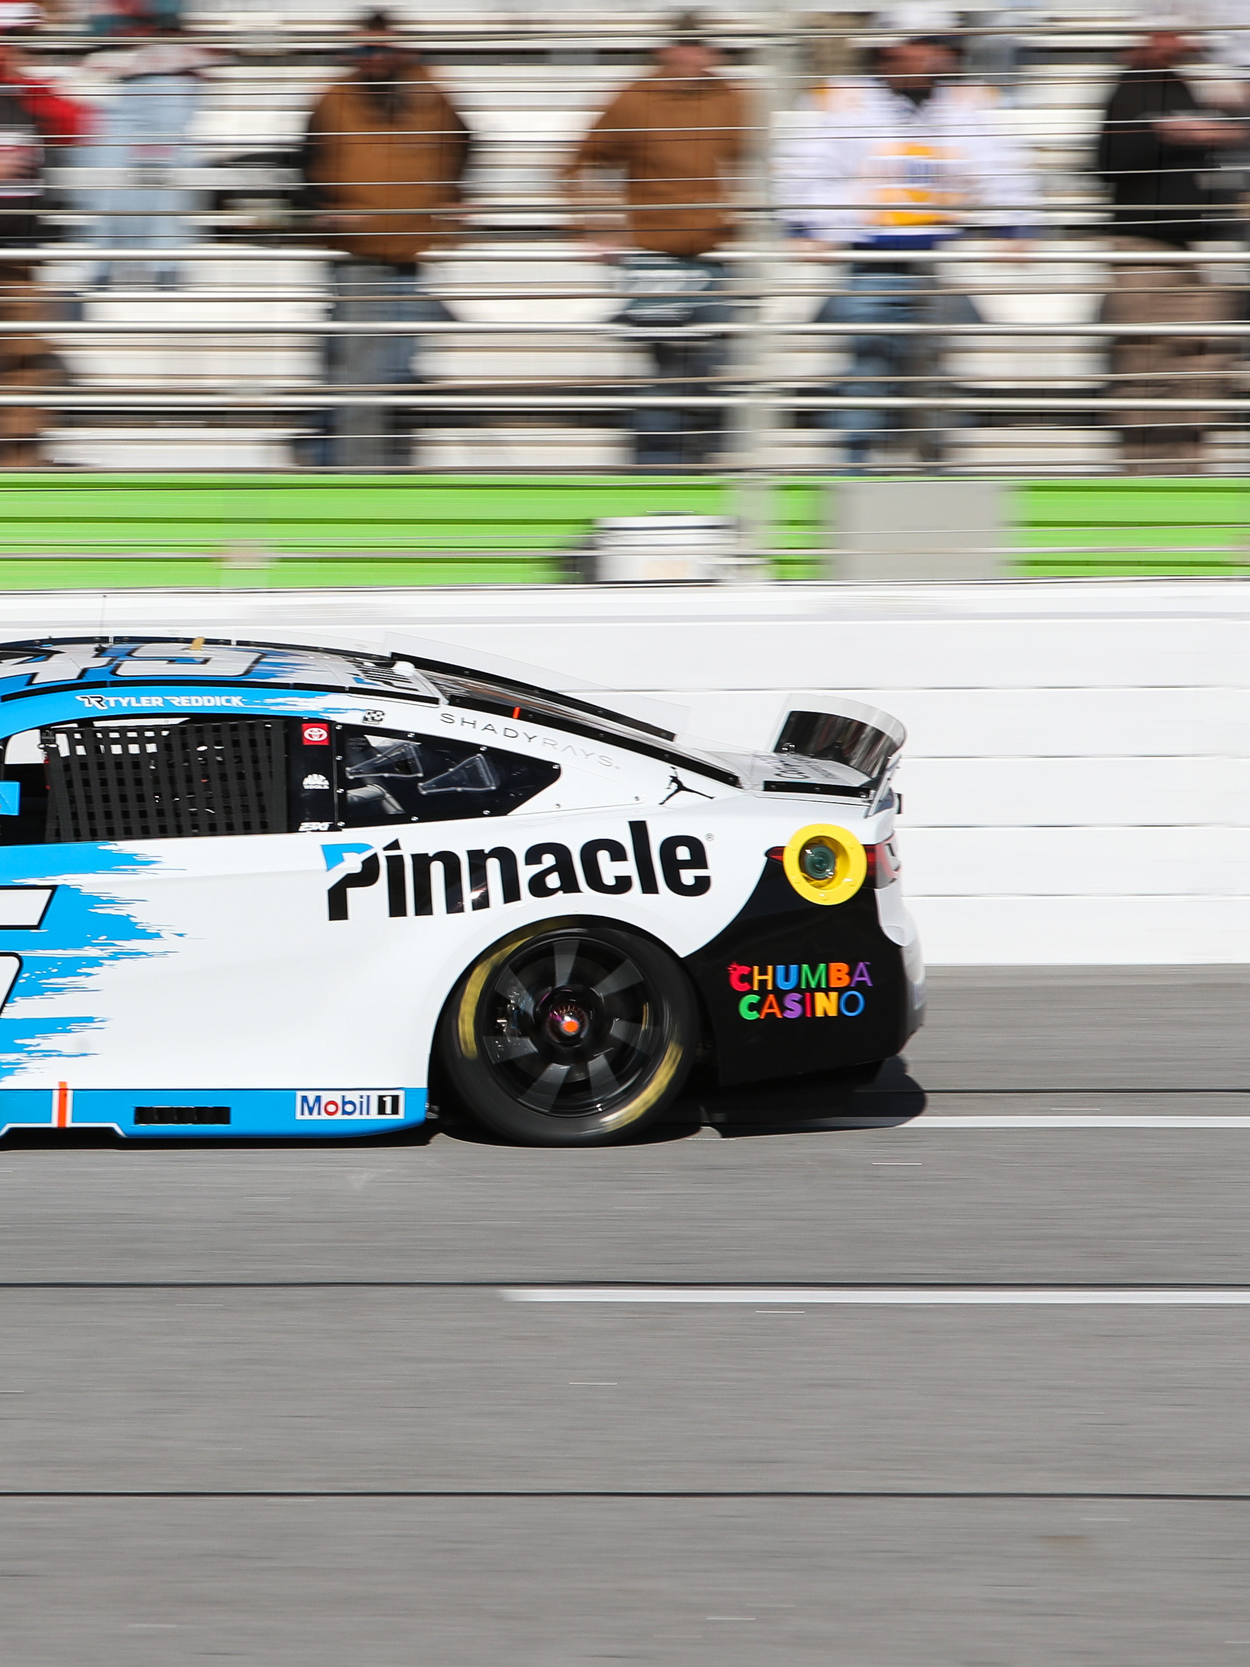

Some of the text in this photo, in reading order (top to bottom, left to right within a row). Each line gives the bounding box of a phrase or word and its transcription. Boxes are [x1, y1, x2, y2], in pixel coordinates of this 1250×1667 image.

[106, 696, 165, 707] TYLER
[164, 695, 245, 707] REDDICK
[321, 820, 711, 921] Pinnacle
[727, 961, 873, 992] CHUMBA
[738, 990, 865, 1020] CASINO
[300, 1094, 394, 1116] Mobil 1
